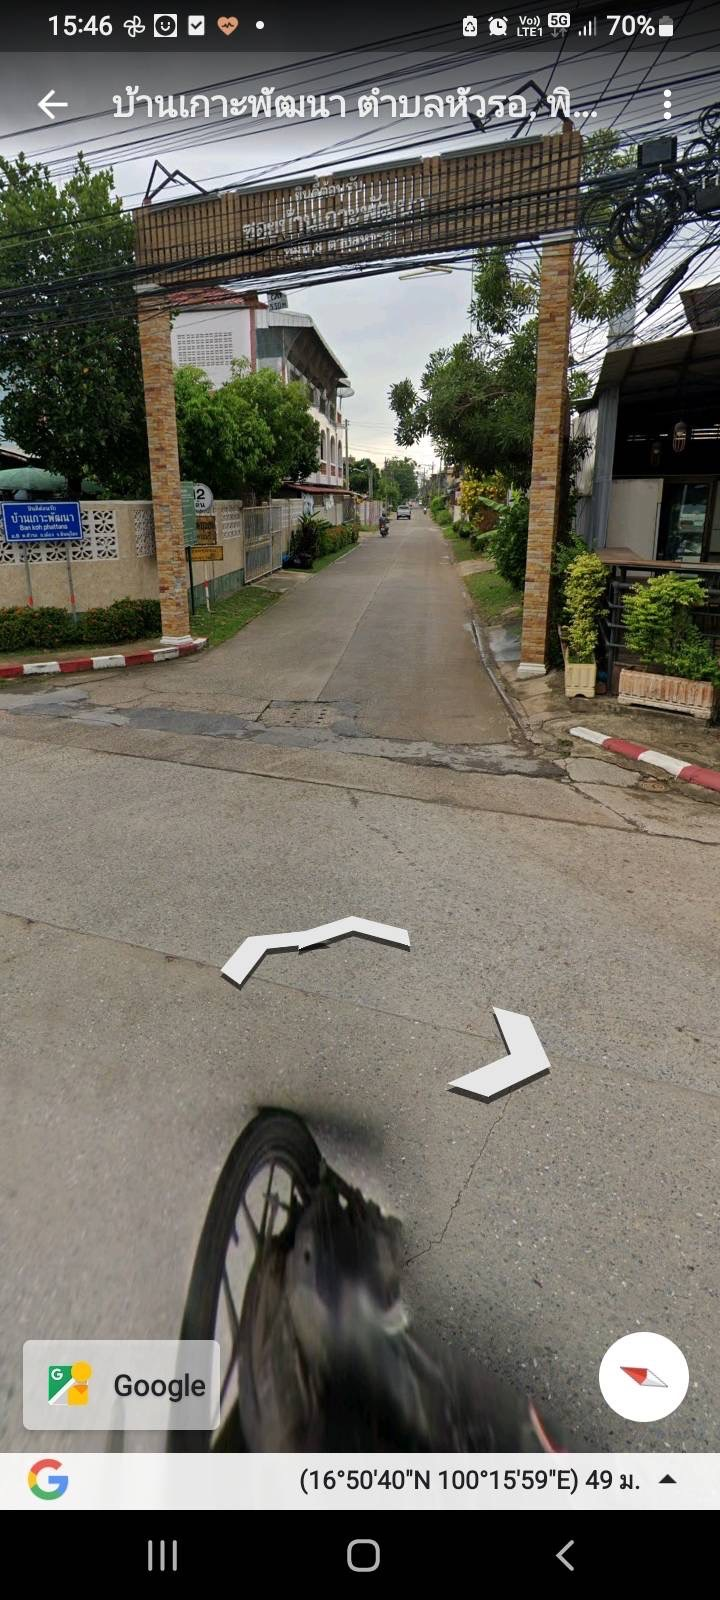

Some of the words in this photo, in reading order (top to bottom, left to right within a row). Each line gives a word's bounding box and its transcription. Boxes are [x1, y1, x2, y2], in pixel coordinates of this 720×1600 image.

[10, 512, 75, 524] บ้านเกาะพัฒนา
